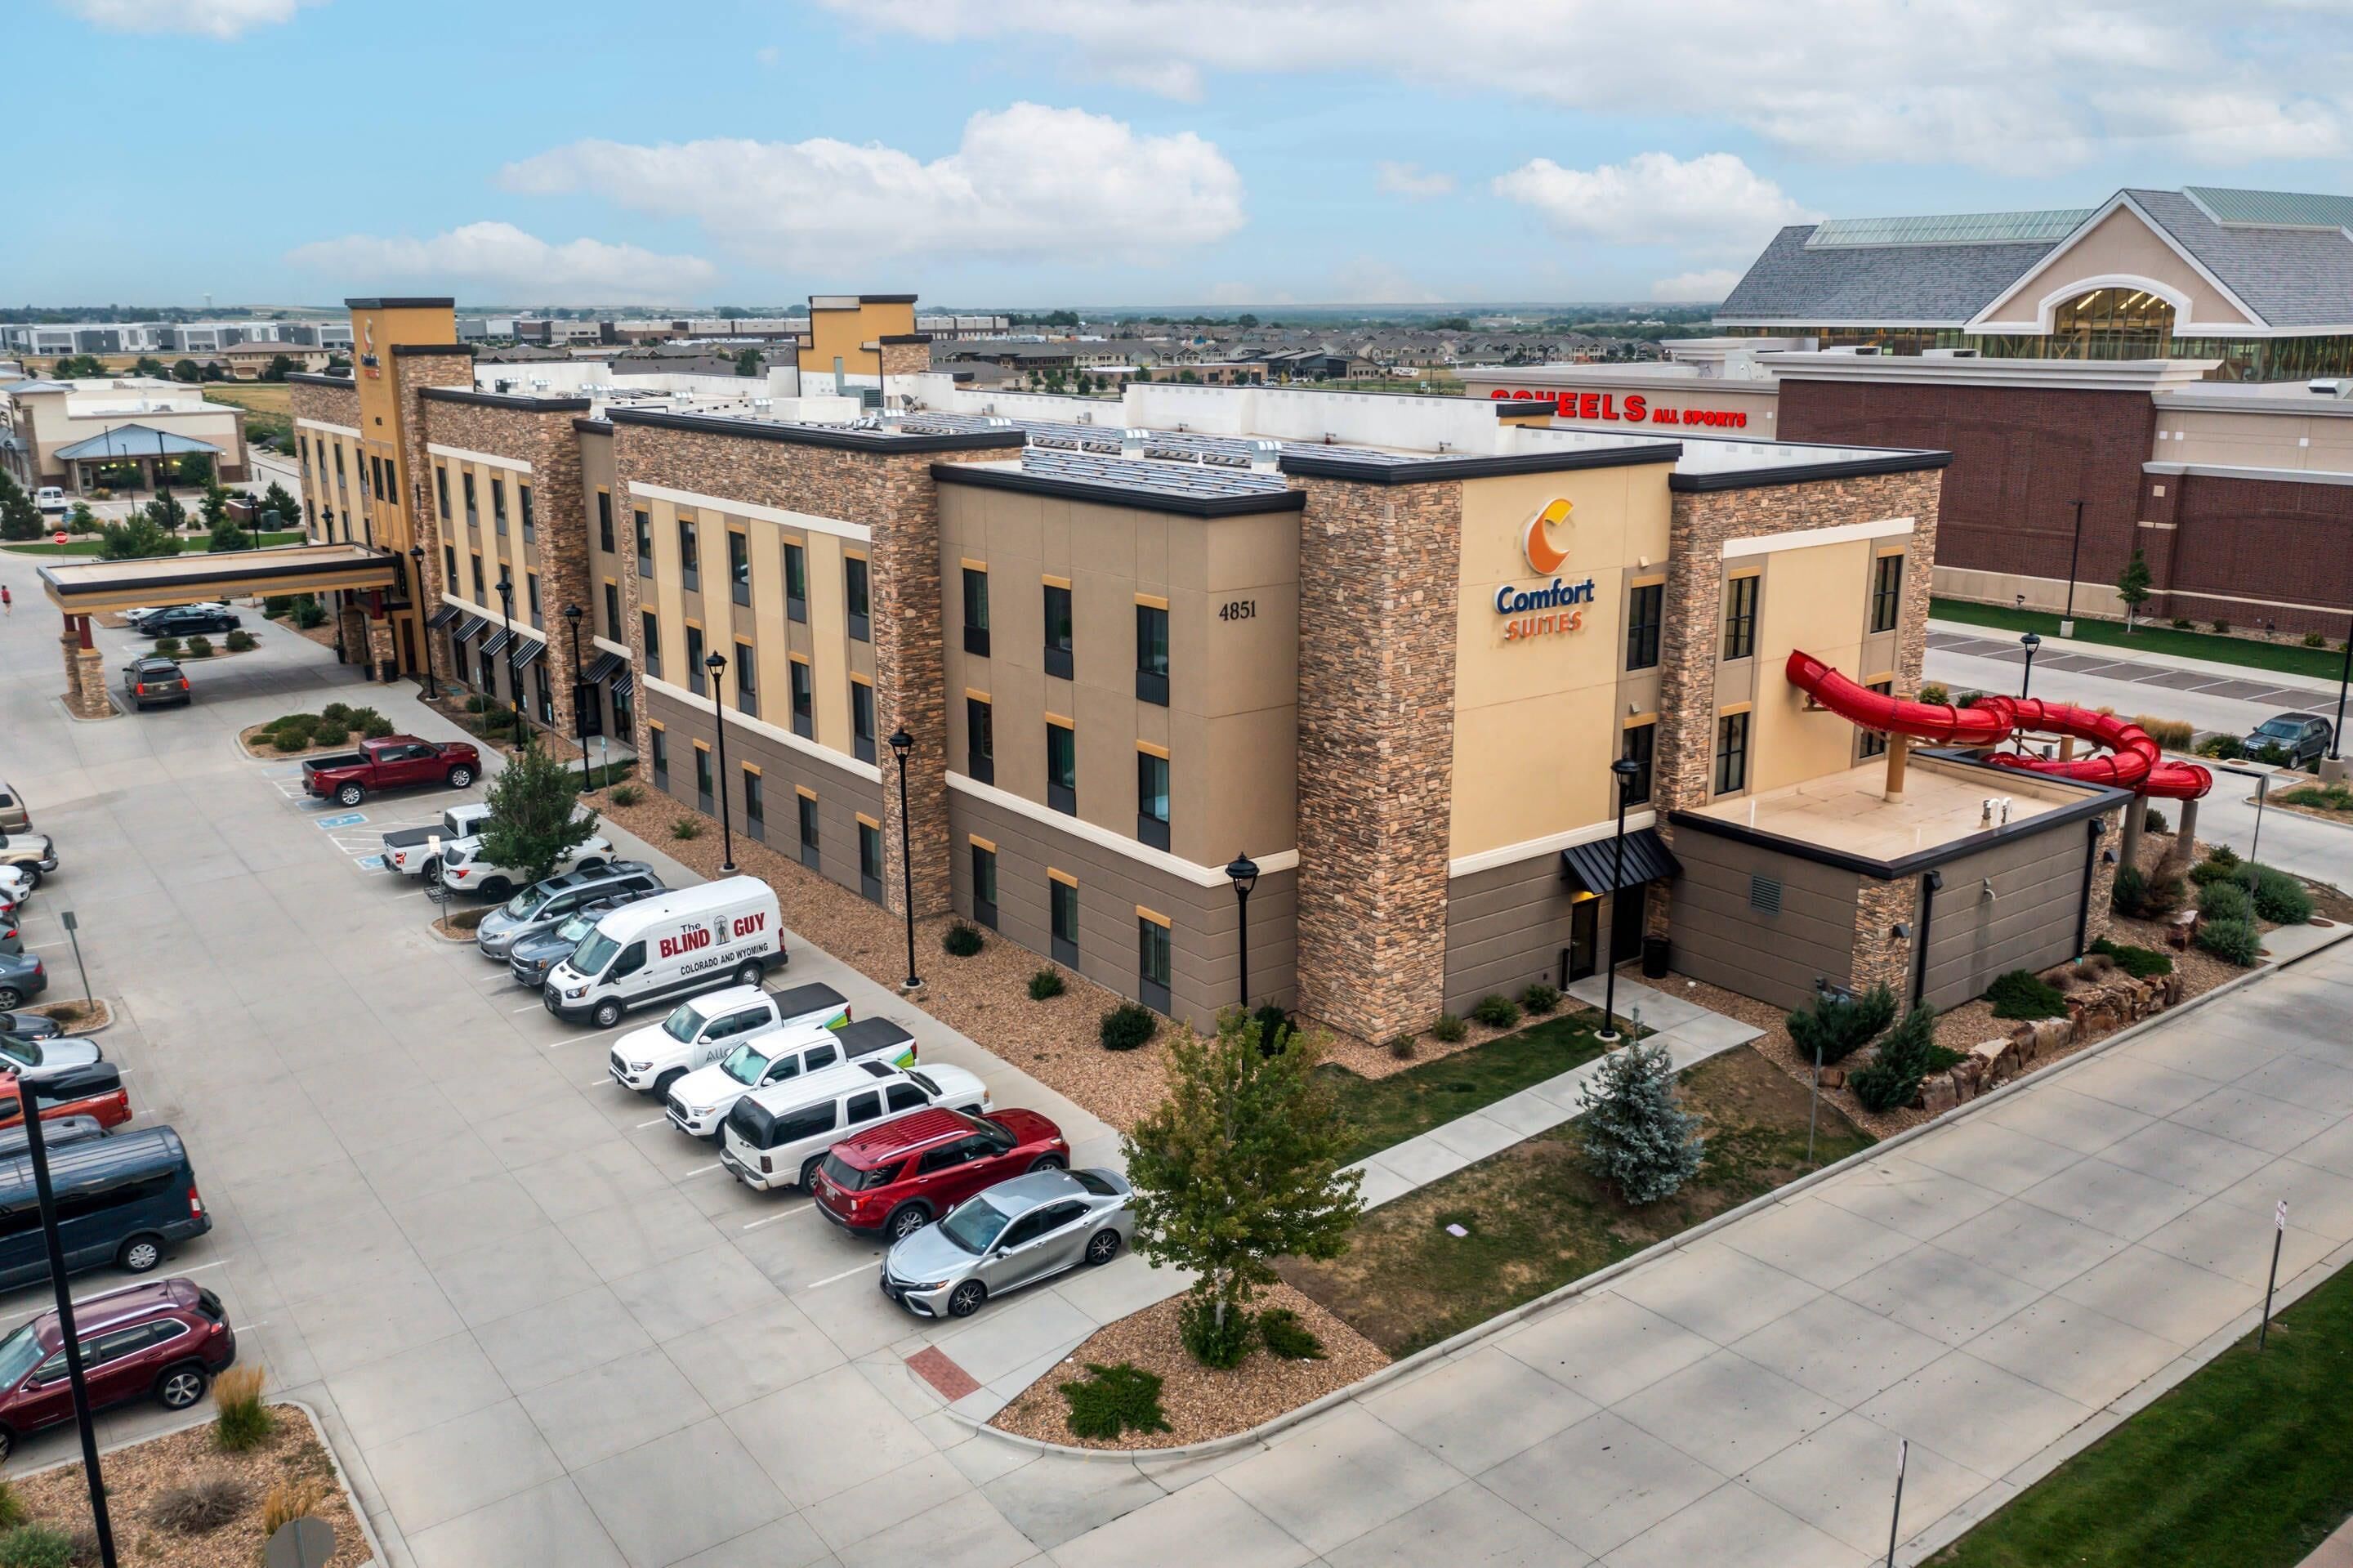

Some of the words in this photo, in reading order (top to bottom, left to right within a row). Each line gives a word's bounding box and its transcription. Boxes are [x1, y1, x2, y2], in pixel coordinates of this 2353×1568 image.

[1653, 409, 1679, 424] ALL
[1683, 410, 1747, 427] SPORTS
[1219, 600, 1256, 621] 4851
[1495, 578, 1595, 614] Comfort
[1504, 610, 1582, 641] SUITES
[659, 928, 711, 958] BLIND
[734, 912, 765, 937] GUY
[681, 922, 701, 933] The
[681, 957, 718, 976] COLORADO
[721, 953, 734, 964] AND
[736, 942, 768, 959] WYOMING
